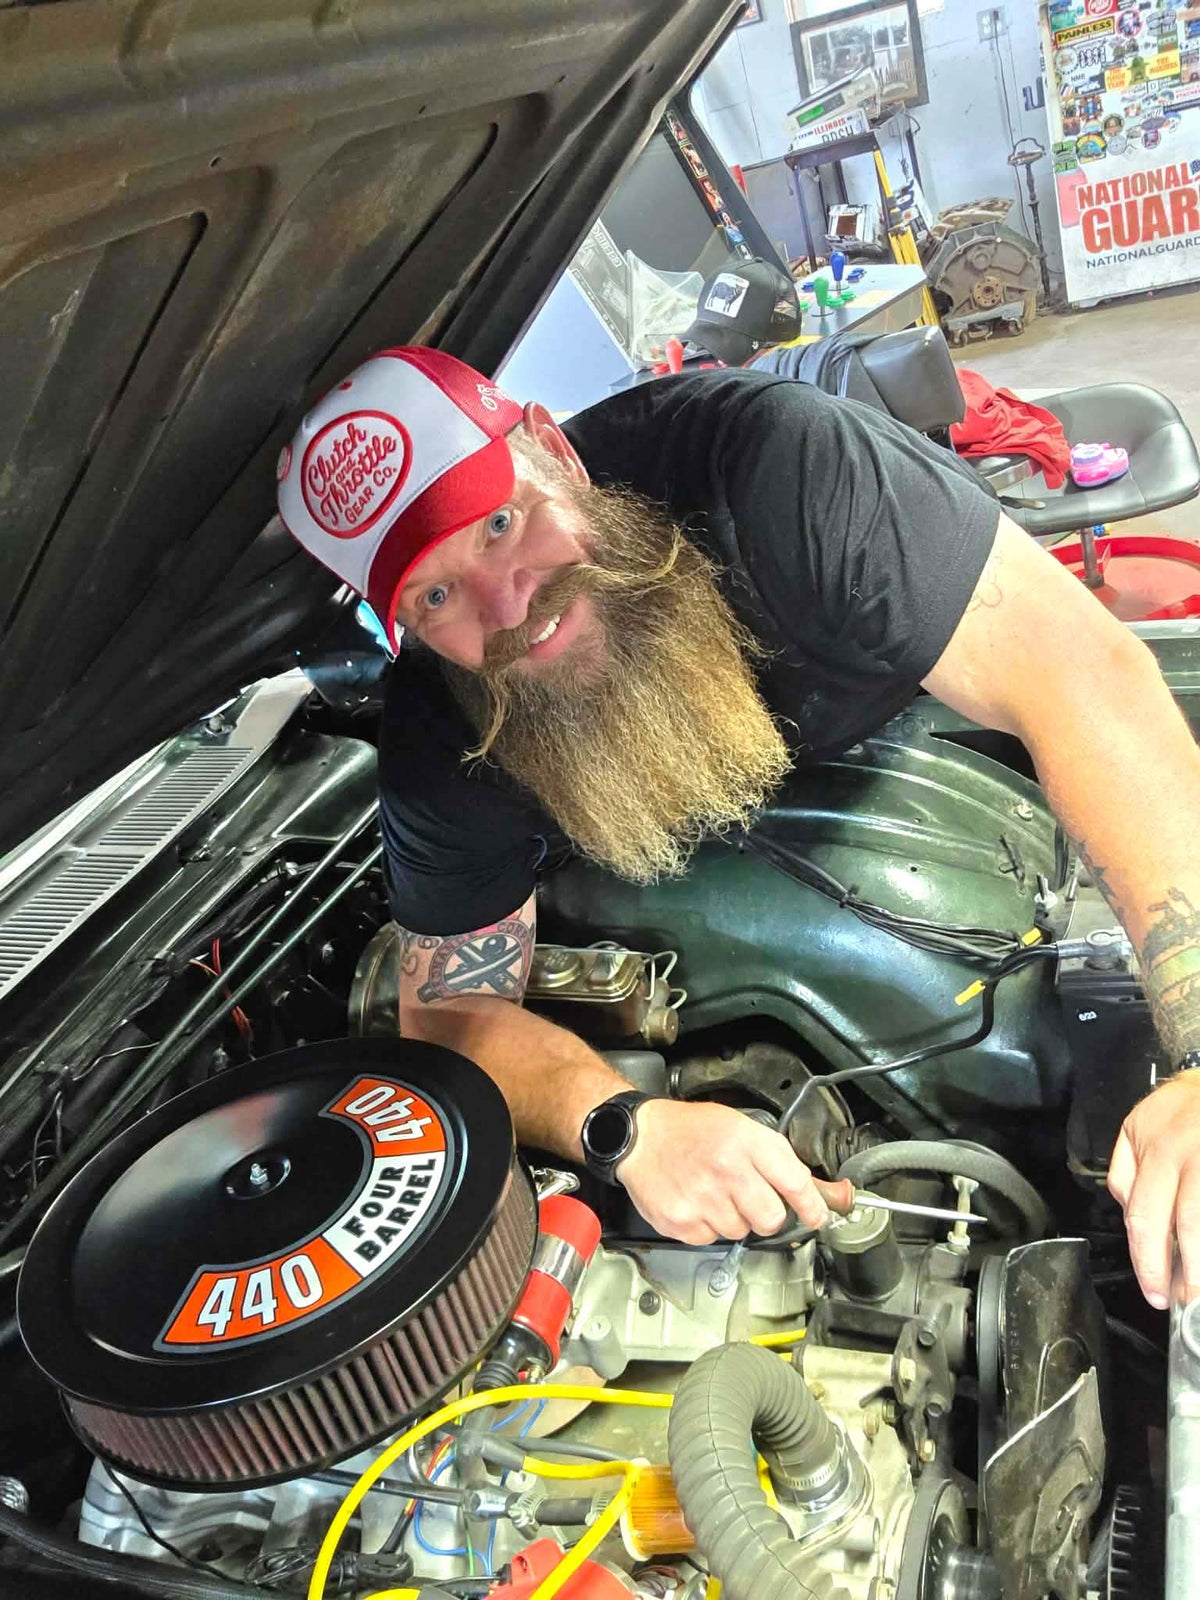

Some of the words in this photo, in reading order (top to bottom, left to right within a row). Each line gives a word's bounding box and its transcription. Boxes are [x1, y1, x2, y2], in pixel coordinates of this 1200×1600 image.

[1057, 20, 1112, 41] PAINLESS
[813, 117, 846, 135] ILLINOIS
[1077, 162, 1193, 210] NATIONAL
[1081, 186, 1200, 254] GUAR
[308, 422, 367, 497] Clutch
[320, 436, 397, 527] Throttle
[344, 488, 375, 525] GEAR
[344, 1085, 433, 1143] 440
[342, 1165, 406, 1238] FOUR
[354, 1158, 436, 1264] BARREL
[197, 1254, 324, 1338] 440
